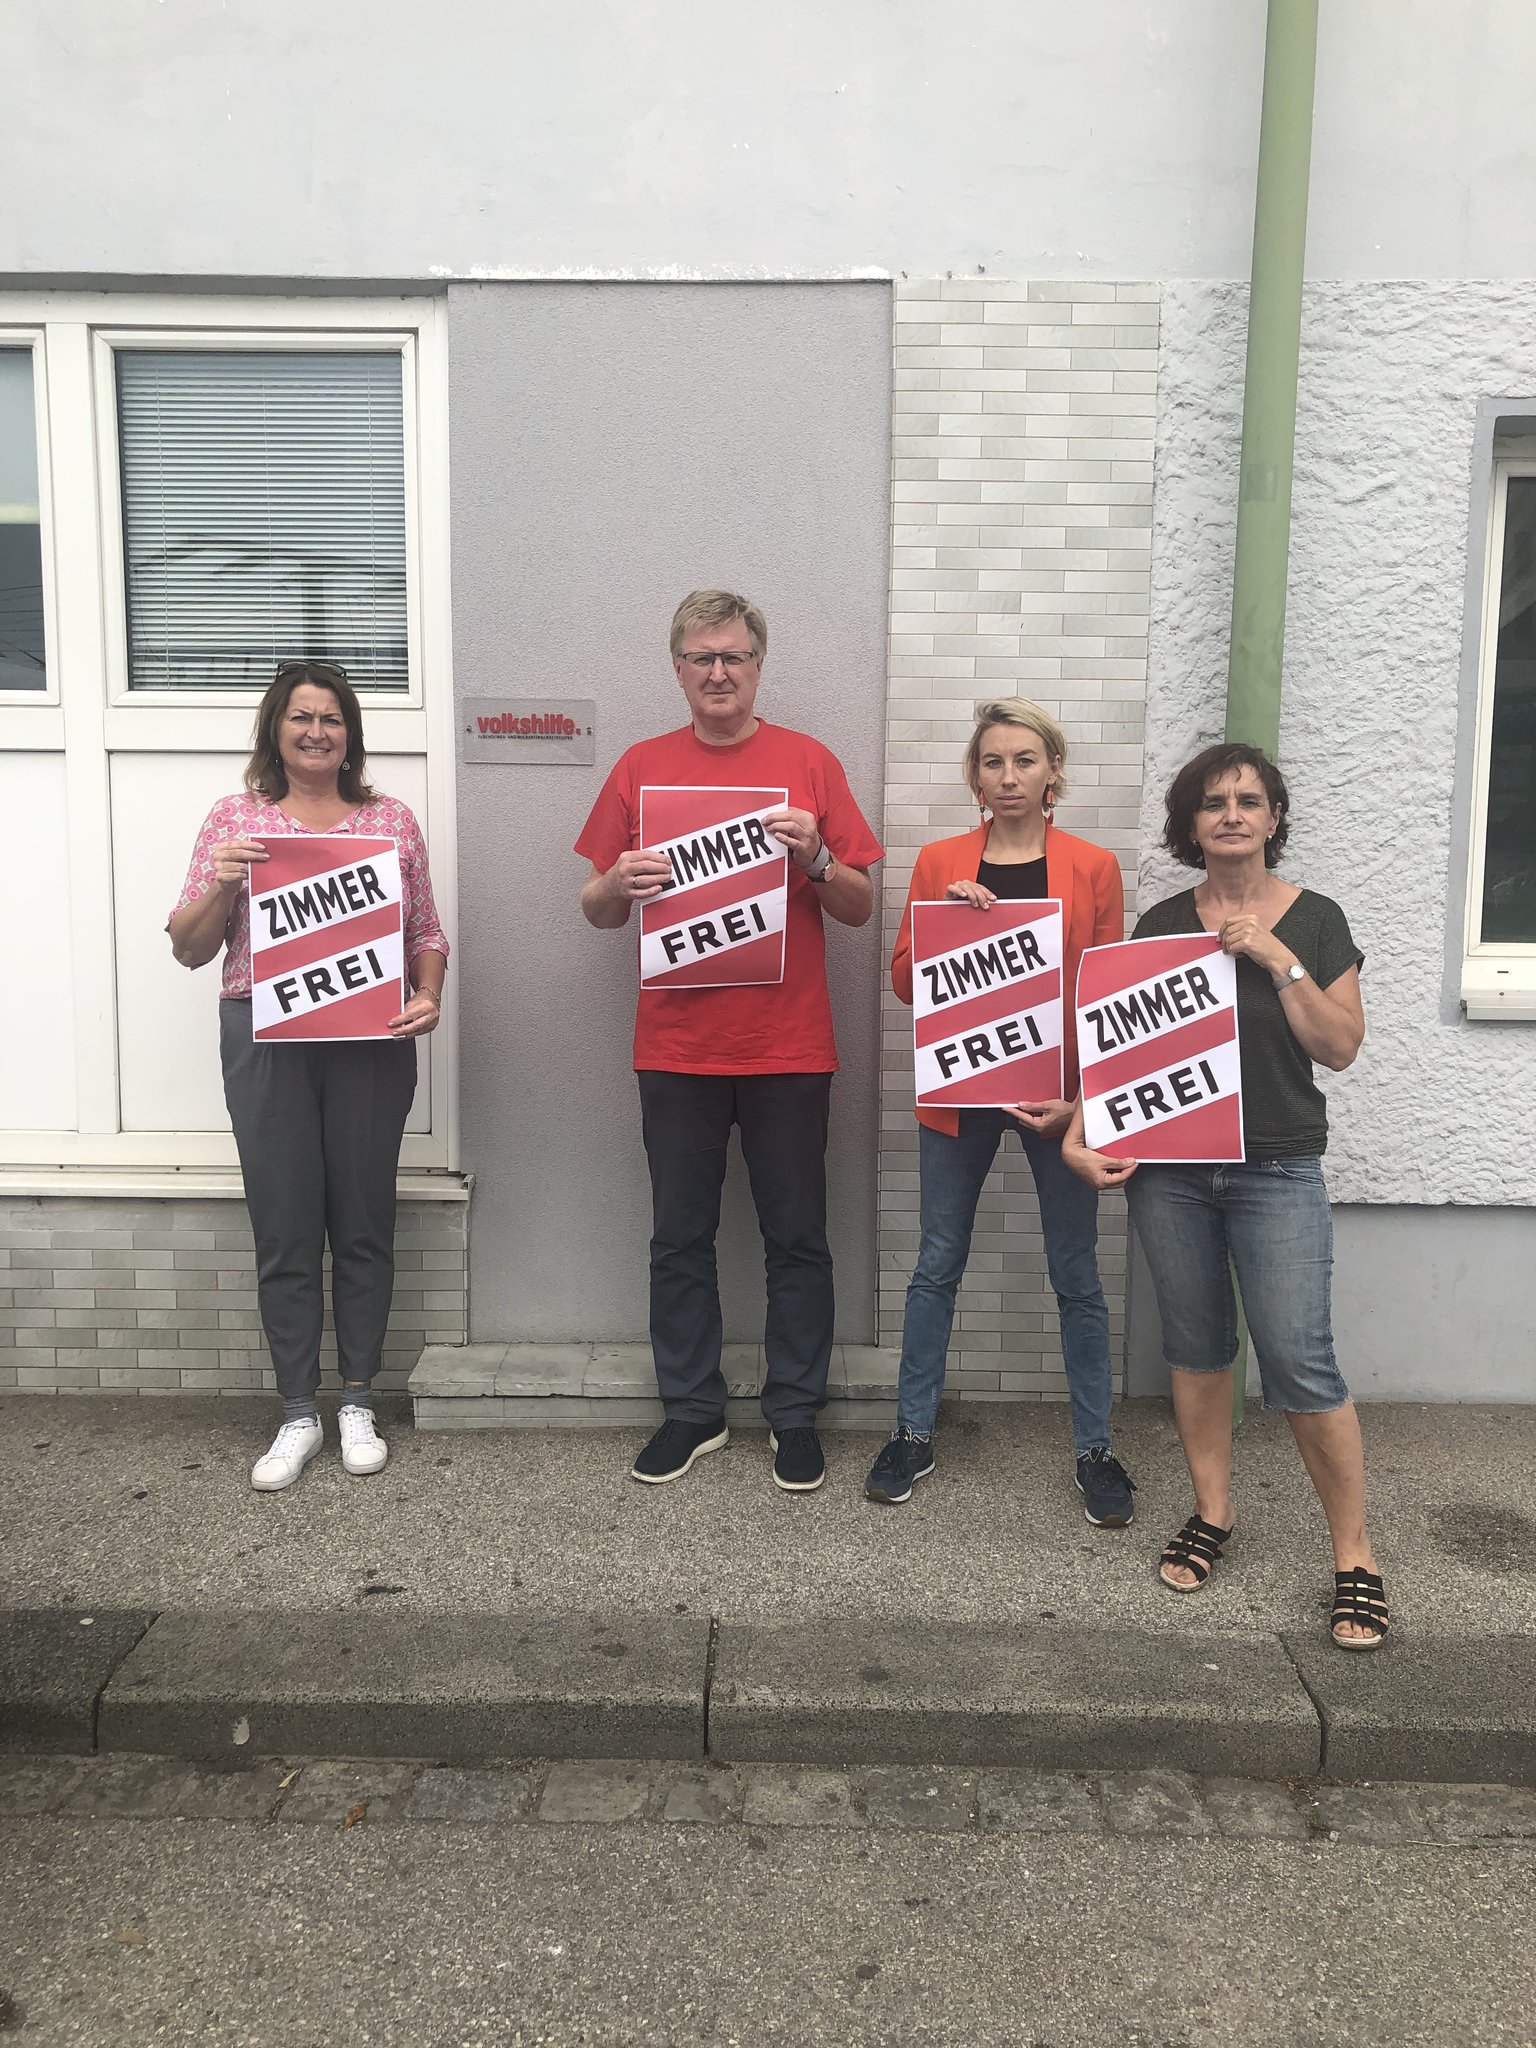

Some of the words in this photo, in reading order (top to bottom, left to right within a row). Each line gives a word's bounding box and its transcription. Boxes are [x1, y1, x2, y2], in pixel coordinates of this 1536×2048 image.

[258, 864, 388, 940] ZIMMER
[660, 902, 767, 965] FREI
[272, 948, 384, 1014] FREI
[920, 929, 1047, 1006] ZIMMER
[1084, 966, 1220, 1053] ZIMMER
[934, 1015, 1043, 1080] FREI
[1104, 1059, 1220, 1132] FREI
